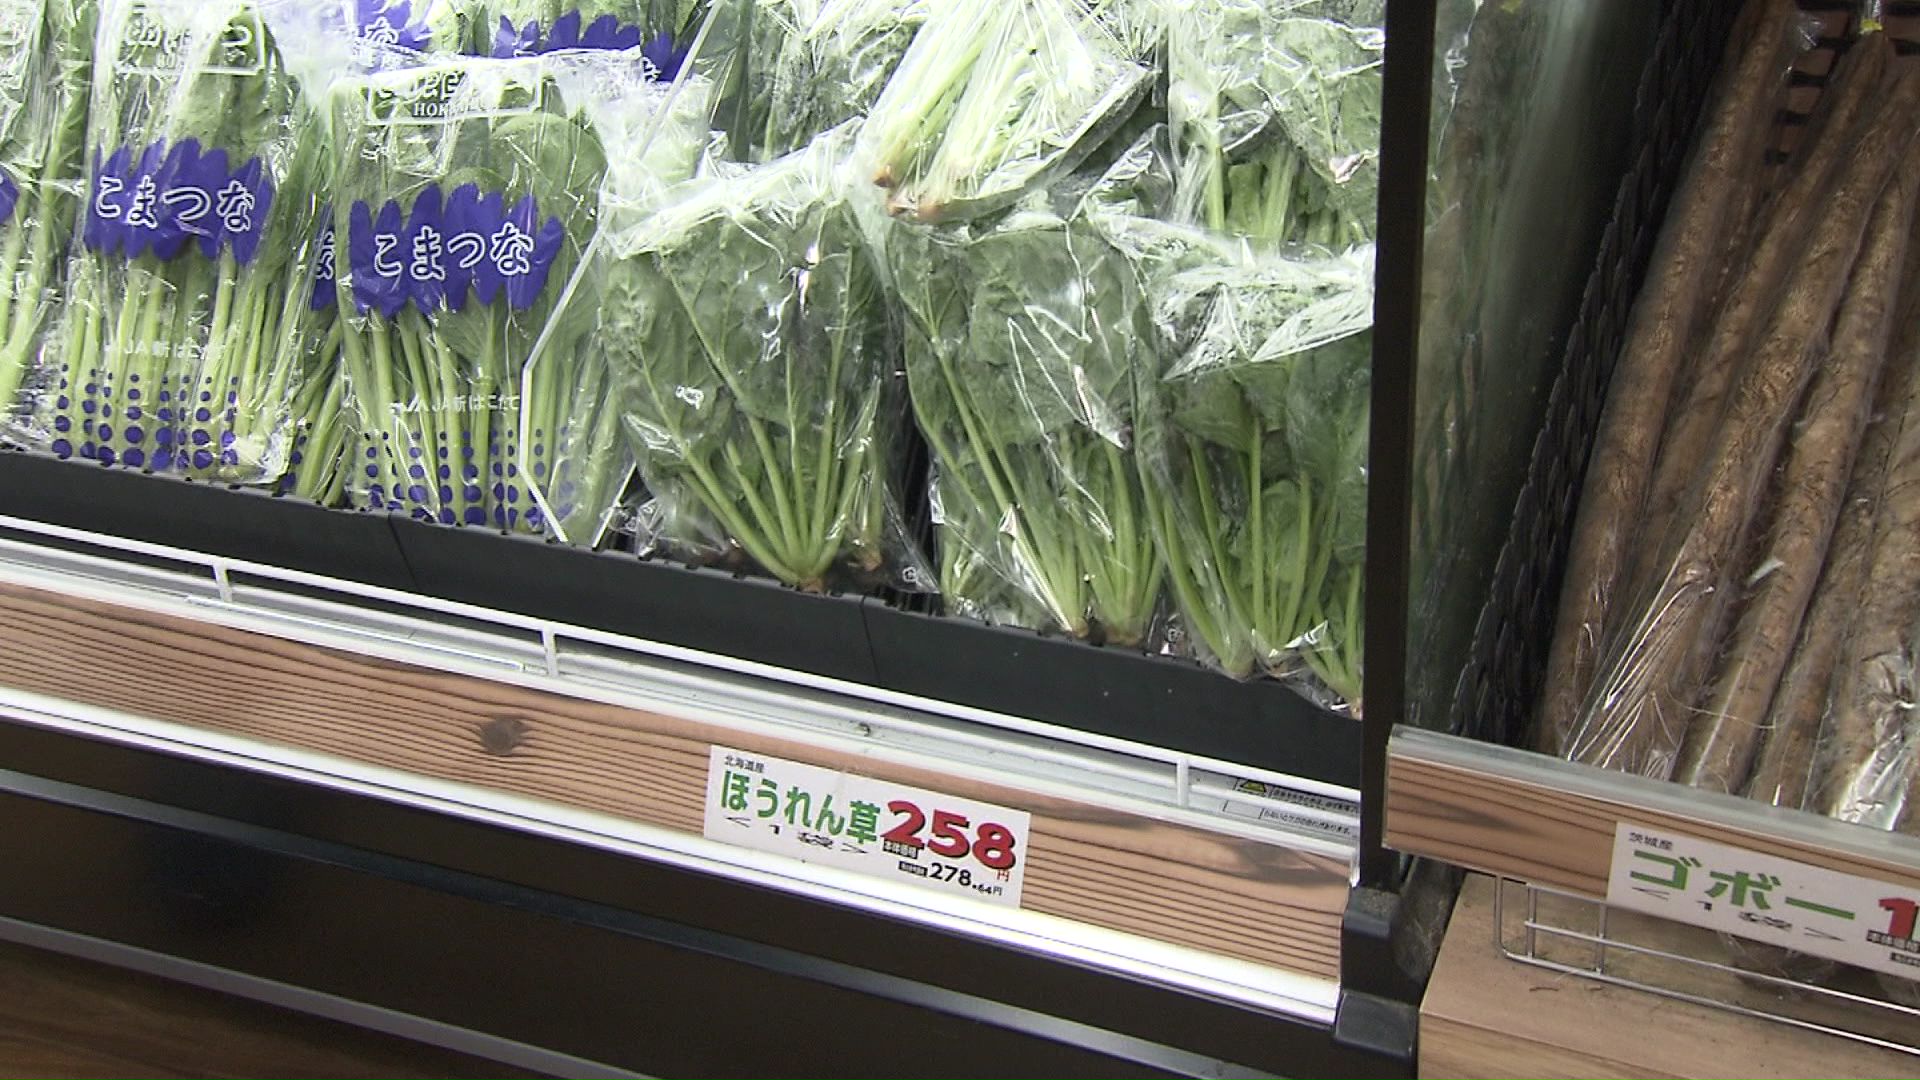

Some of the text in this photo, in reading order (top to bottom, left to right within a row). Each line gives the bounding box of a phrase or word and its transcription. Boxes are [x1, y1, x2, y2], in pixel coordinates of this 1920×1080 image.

[95, 174, 255, 233] こまつな
[374, 221, 534, 283] こまつな
[724, 755, 765, 774] 北海道産
[720, 770, 881, 846] ほうれん草
[1629, 832, 1673, 850] 茨城産
[1629, 849, 1856, 921] ゴボー
